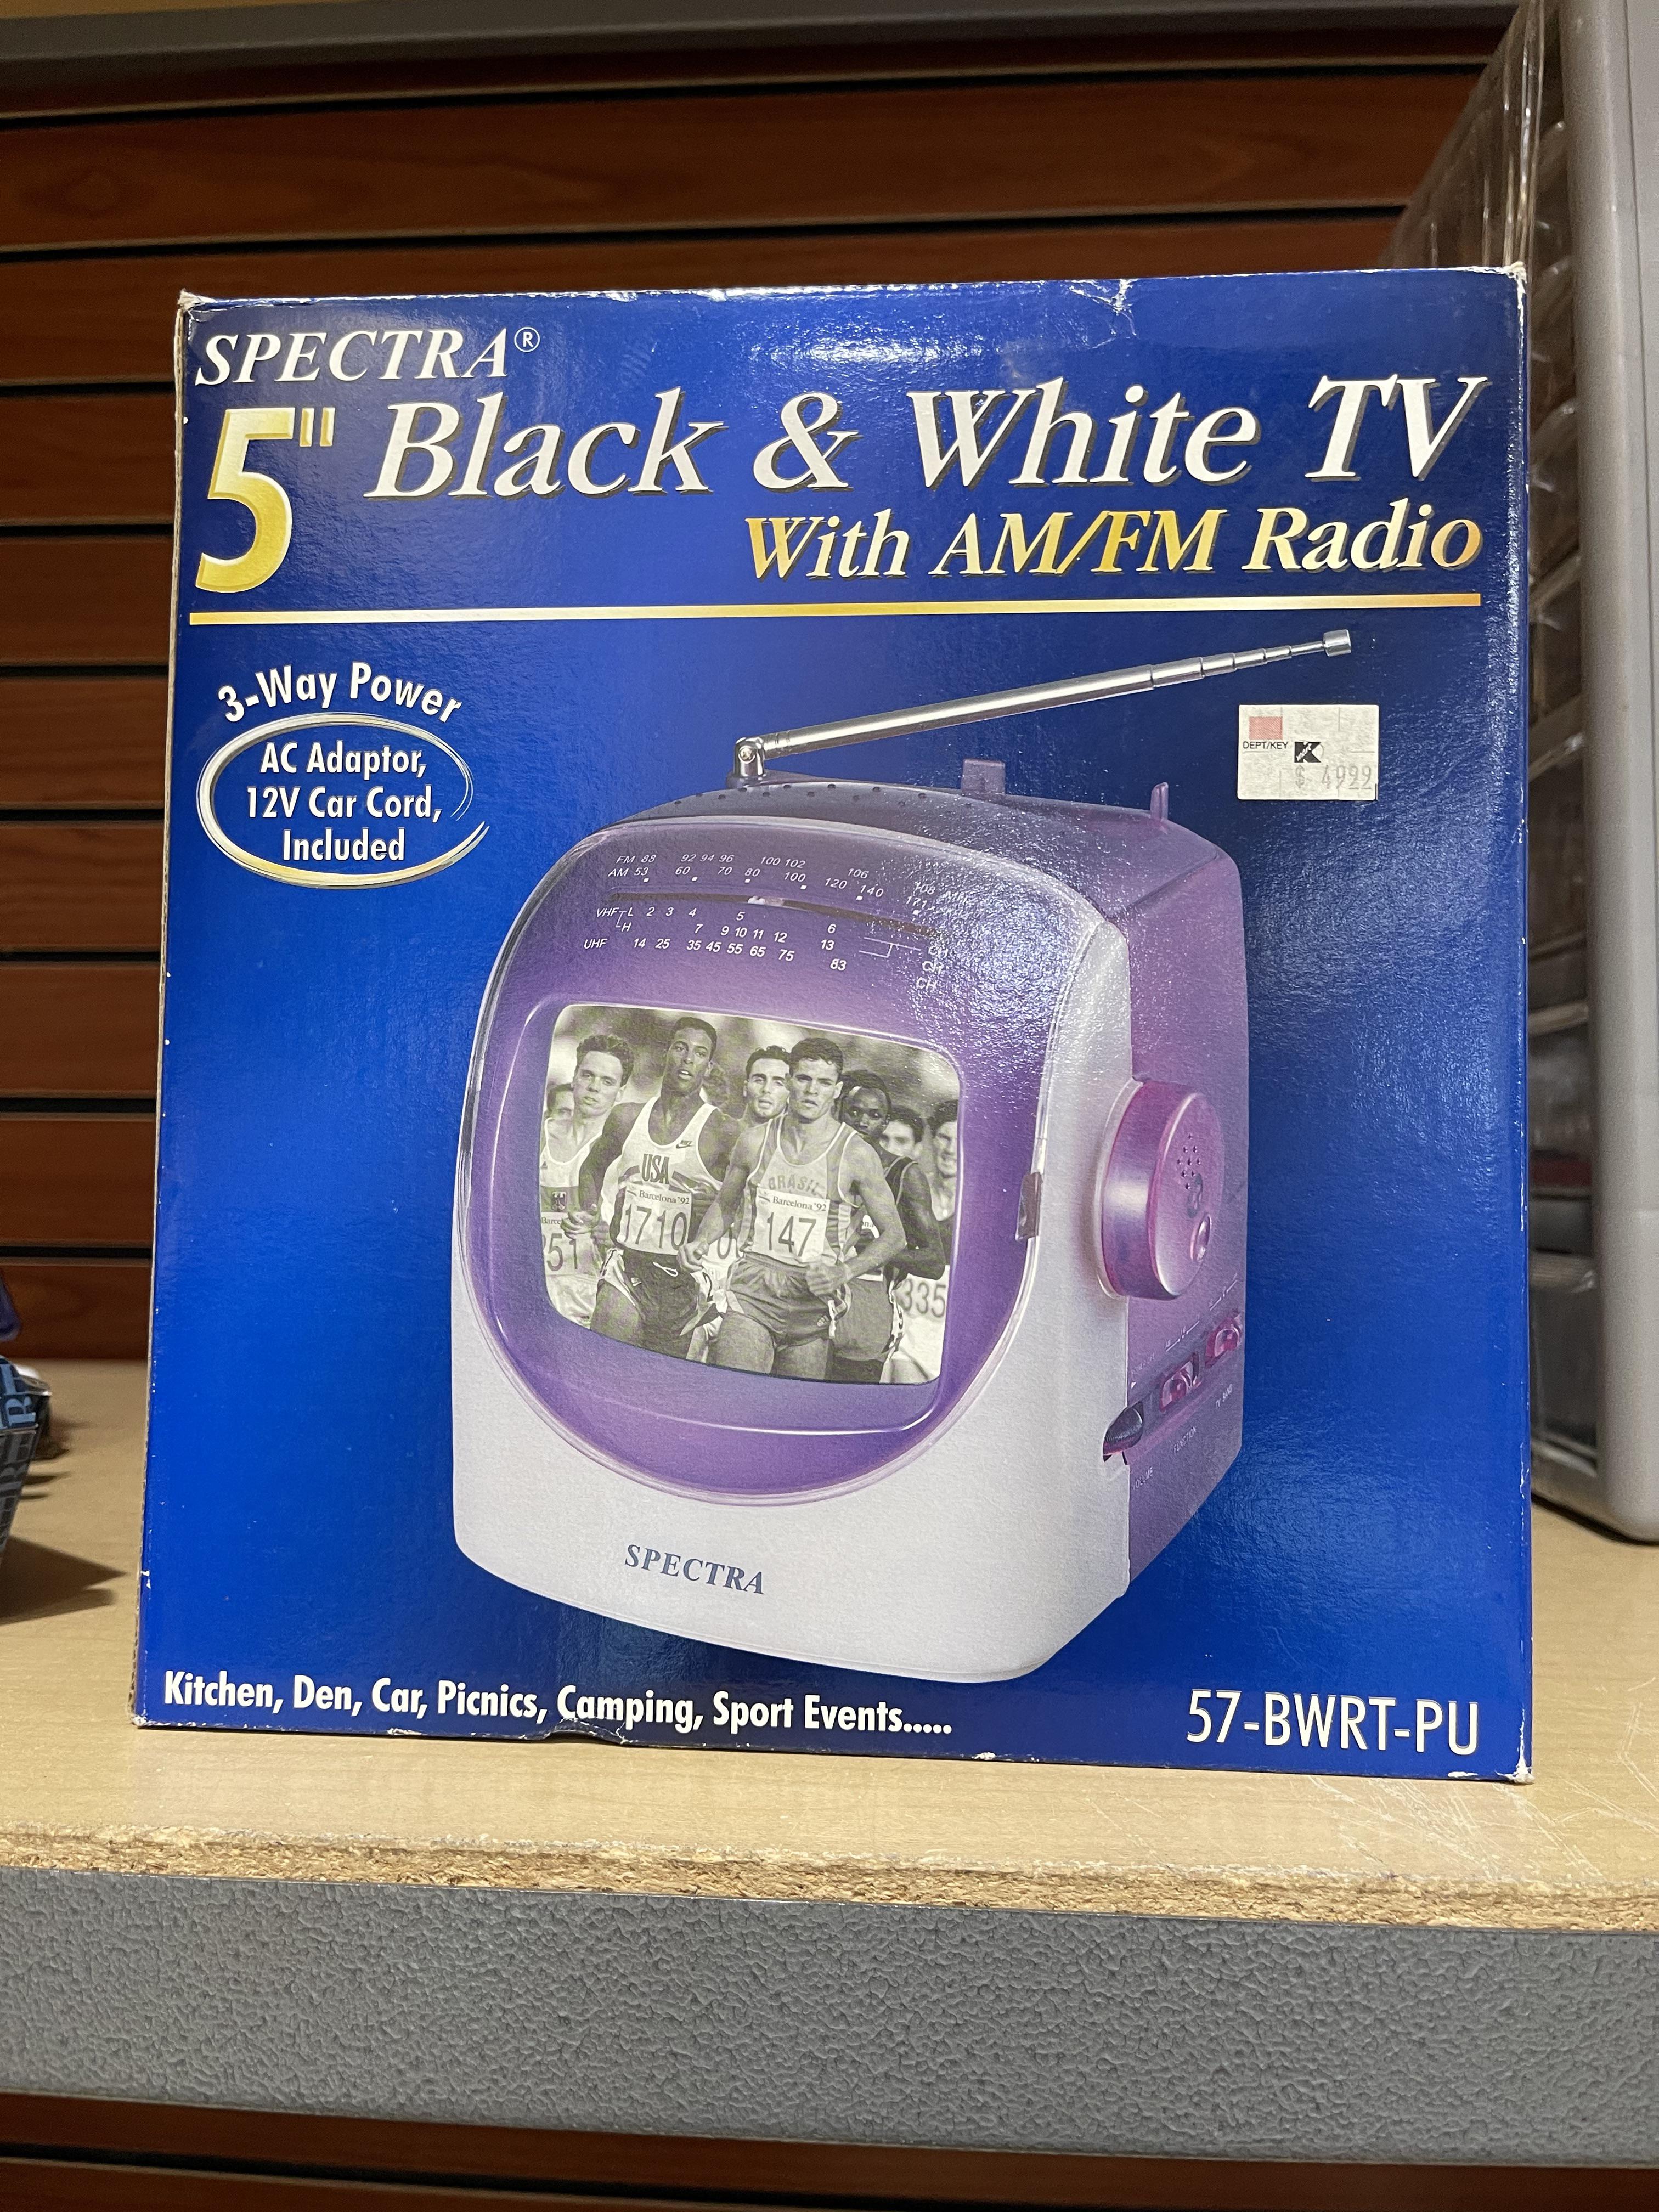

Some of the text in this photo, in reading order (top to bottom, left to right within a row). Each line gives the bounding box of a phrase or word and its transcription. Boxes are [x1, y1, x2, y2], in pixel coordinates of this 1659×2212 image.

[364, 387, 727, 498] Black
[753, 392, 859, 490] &
[906, 377, 1260, 488] White
[1304, 374, 1488, 483] TV
[745, 498, 1483, 580] With AM/FM Radio
[218, 661, 462, 723] 3-Way Power
[260, 740, 426, 781] AC Adaptor,
[1243, 741, 1289, 749] DEPT/KEY
[247, 783, 442, 823] 12V Car Cord,
[283, 827, 405, 861] Included
[607, 868, 629, 877] AM
[634, 867, 649, 876] 53
[675, 866, 690, 875] 60
[718, 867, 732, 875] 70
[744, 868, 760, 877] 80
[785, 872, 806, 882] 100
[825, 878, 848, 889] 120
[860, 885, 884, 898] 140
[616, 855, 635, 864] FM
[641, 855, 656, 863] 88
[761, 856, 781, 866] 100
[785, 859, 806, 868] 102
[848, 868, 869, 878] 106
[596, 907, 619, 917] VHF
[646, 907, 654, 916] 2
[665, 907, 674, 916] 3
[689, 909, 697, 917] 4
[736, 911, 745, 921] 5
[827, 923, 837, 934] 6
[621, 922, 631, 932] H
[695, 924, 703, 934] 7
[720, 926, 729, 936] 9
[735, 927, 747, 938] 10
[753, 929, 764, 940] 11
[774, 932, 787, 943] 12
[821, 939, 834, 950] 13
[584, 938, 607, 949] UHF
[634, 938, 646, 949] 14
[655, 938, 670, 949] 25
[686, 940, 702, 951] 35
[706, 941, 721, 952] 45
[727, 943, 743, 955] 55
[749, 945, 766, 957] 65
[778, 949, 794, 961] 75
[830, 958, 847, 971] 83
[641, 1153, 670, 1185] USA
[639, 1190, 676, 1204] Barcelona
[772, 1196, 812, 1210] Barcelona
[623, 1203, 688, 1251] 1710
[766, 1211, 817, 1257] 147
[542, 1233, 578, 1272] 51
[624, 1544, 764, 1595] SPECTRA
[164, 1671, 284, 1716] Kitchen,
[293, 1675, 362, 1716] Den,
[371, 1678, 428, 1717] Car,
[437, 1680, 546, 1725] Picnics,
[556, 1685, 703, 1733] Camping,
[713, 1692, 794, 1734] Sport
[1187, 1688, 1479, 1756] 57-BWRT-PU
